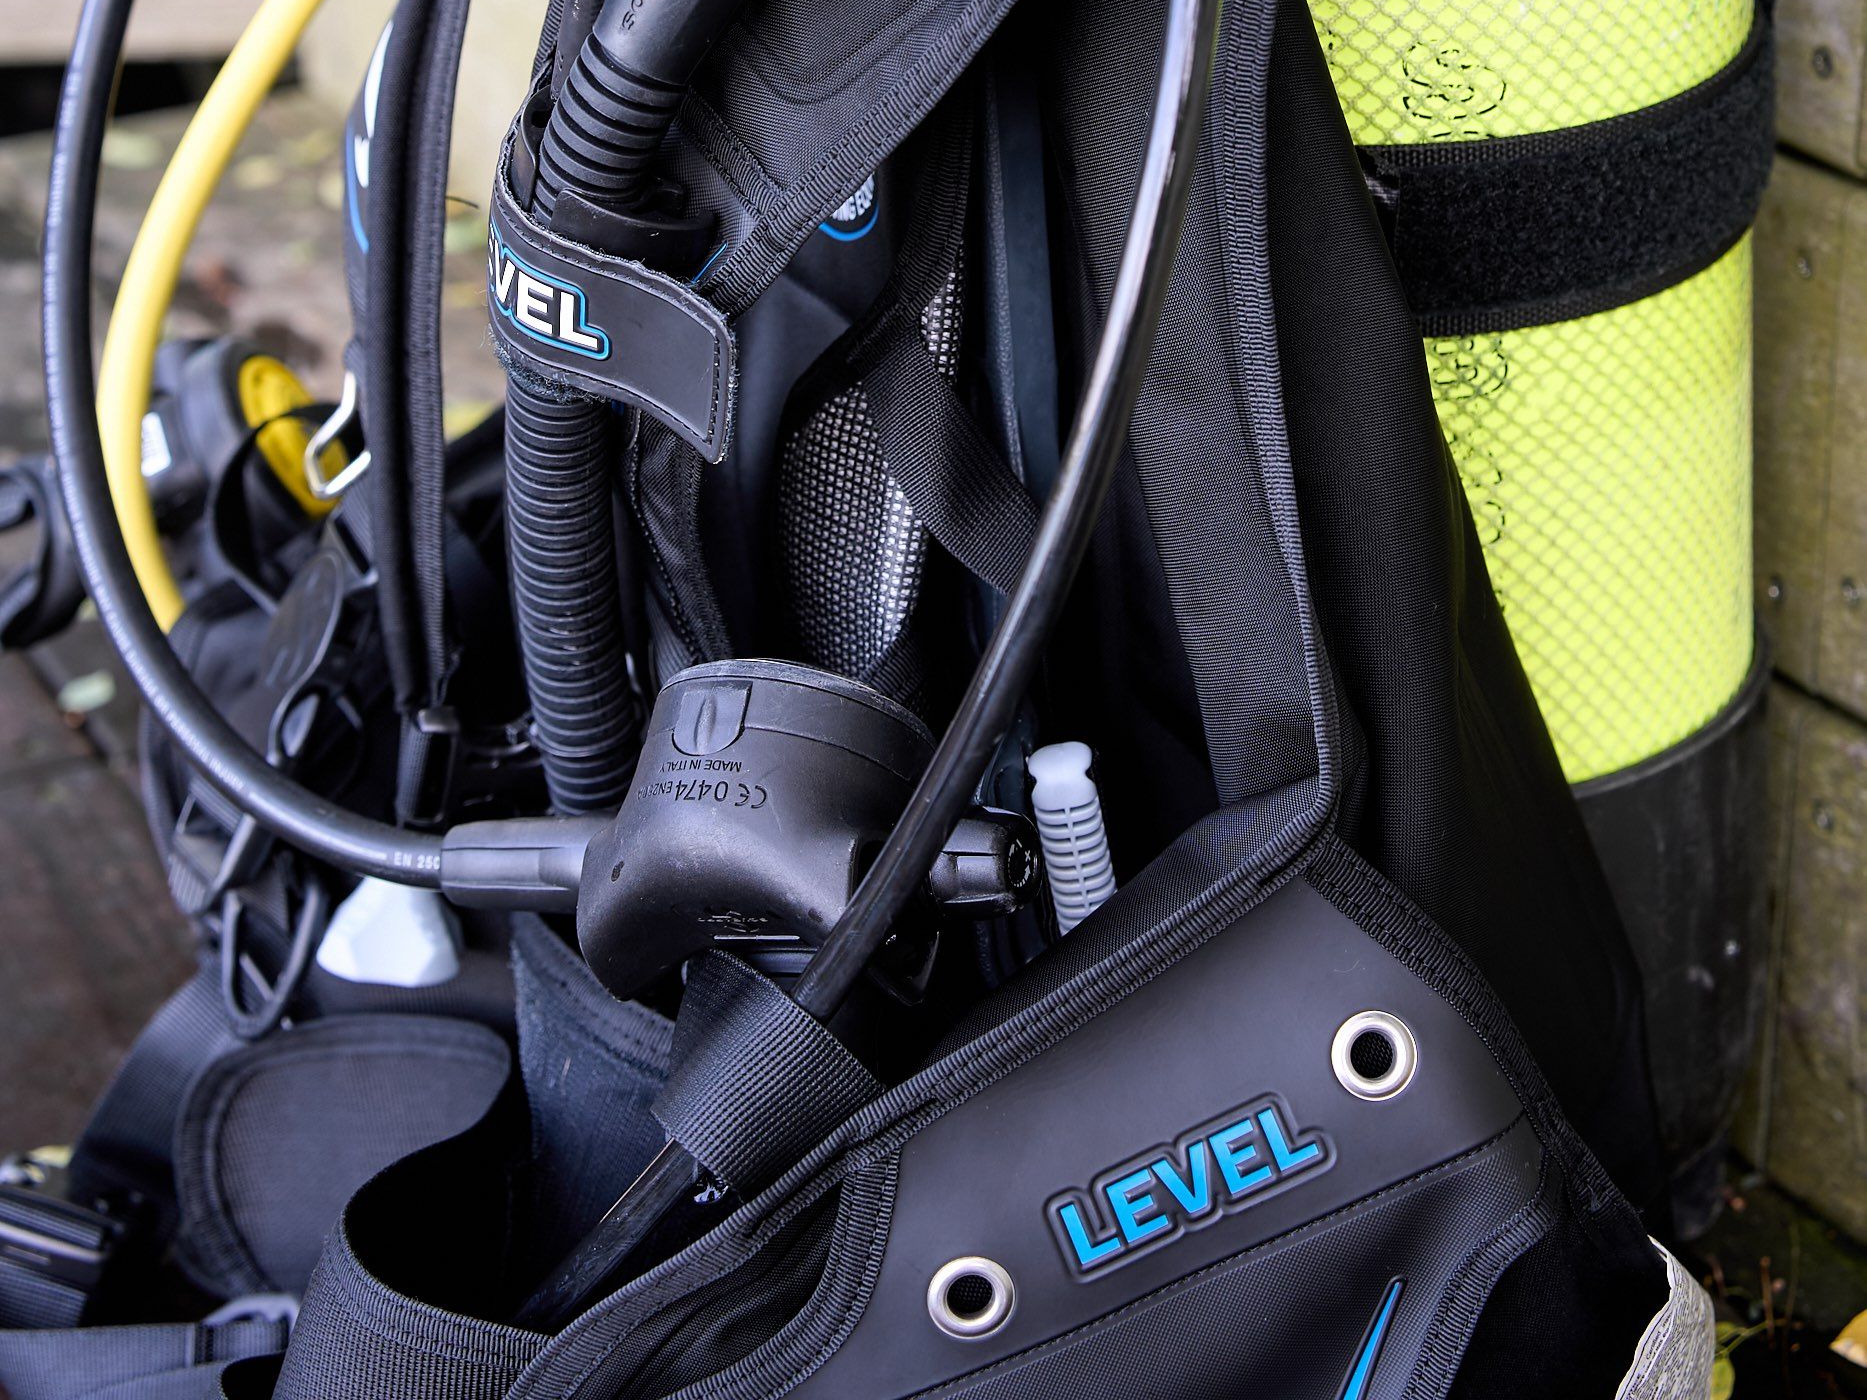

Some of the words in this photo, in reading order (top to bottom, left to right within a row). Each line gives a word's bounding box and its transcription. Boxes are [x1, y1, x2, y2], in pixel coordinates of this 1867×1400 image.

[658, 761, 687, 773] ITALY
[689, 759, 701, 770] IN
[705, 759, 743, 773] MADE
[673, 779, 730, 802] 0474
[393, 851, 413, 868] EN
[1059, 1107, 1320, 1268] LEVEL
